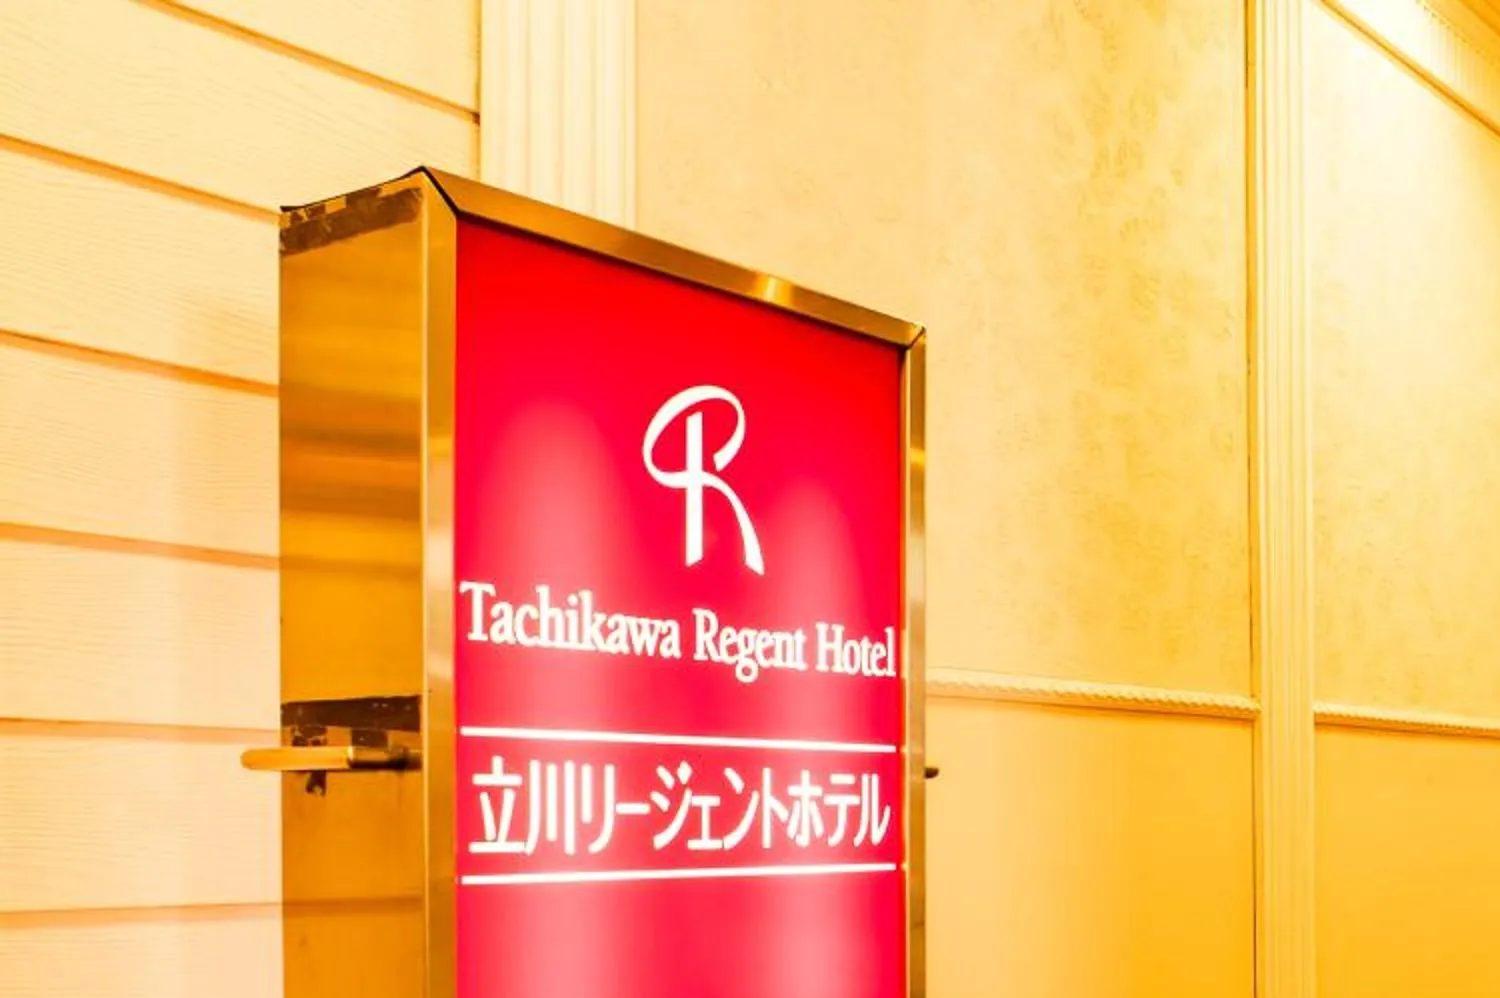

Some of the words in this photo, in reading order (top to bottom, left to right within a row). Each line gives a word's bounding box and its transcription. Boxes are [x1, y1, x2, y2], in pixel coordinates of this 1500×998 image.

[459, 580, 682, 659] Tachikawa
[693, 608, 809, 683] Regent
[815, 622, 897, 677] Hotel
[468, 754, 891, 857] 立川リージェントホテル
